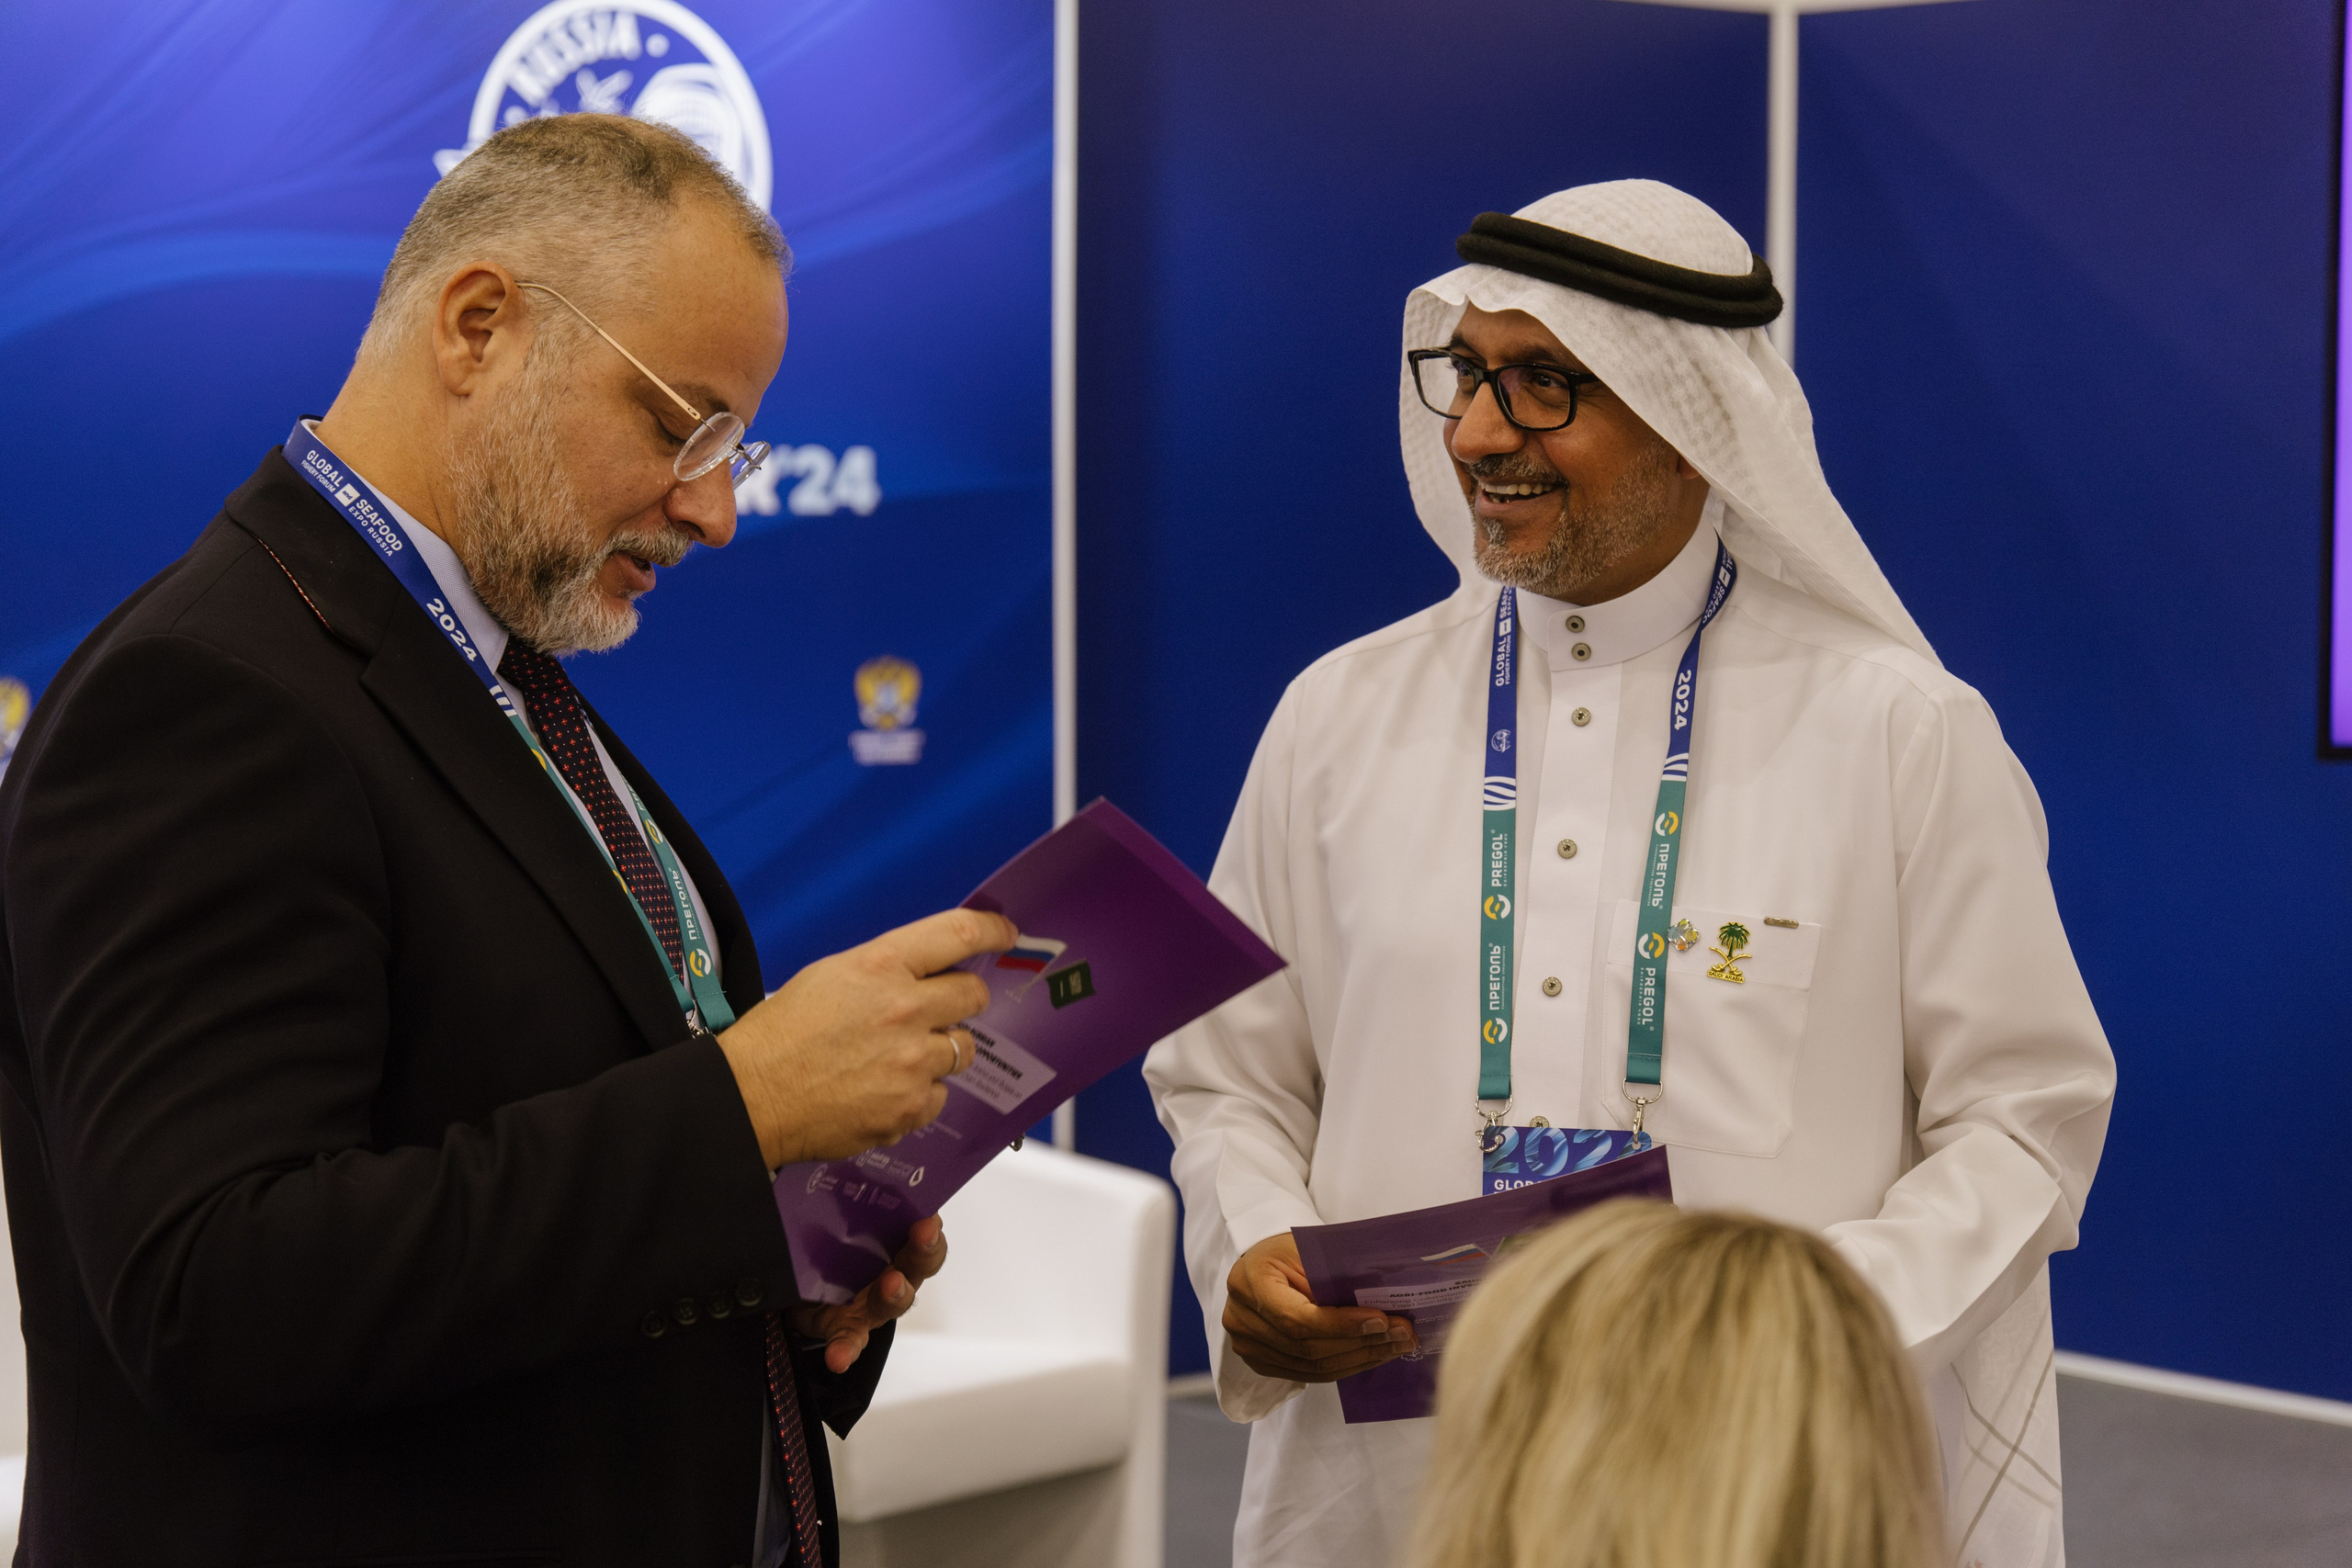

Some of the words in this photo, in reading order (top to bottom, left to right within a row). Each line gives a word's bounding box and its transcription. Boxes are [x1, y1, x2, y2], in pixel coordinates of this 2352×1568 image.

[301, 459, 319, 477] FISHERY
[316, 474, 336, 492] FORUM
[306, 449, 344, 487] GLOBAL
[342, 491, 354, 501] and
[348, 506, 368, 526] EXPO
[368, 527, 393, 557] RUSSIA
[356, 499, 402, 551] SEAFOOD
[425, 598, 478, 662] 2024
[1496, 637, 1507, 687] GLOBAL
[1674, 669, 1692, 730] 2024
[1492, 833, 1503, 887] PREGOL
[1652, 843, 1670, 908] ПРЕГОЛЬ
[1489, 945, 1501, 1010] ПРЕГОЛЬ
[1642, 967, 1656, 1025] PREGOL
